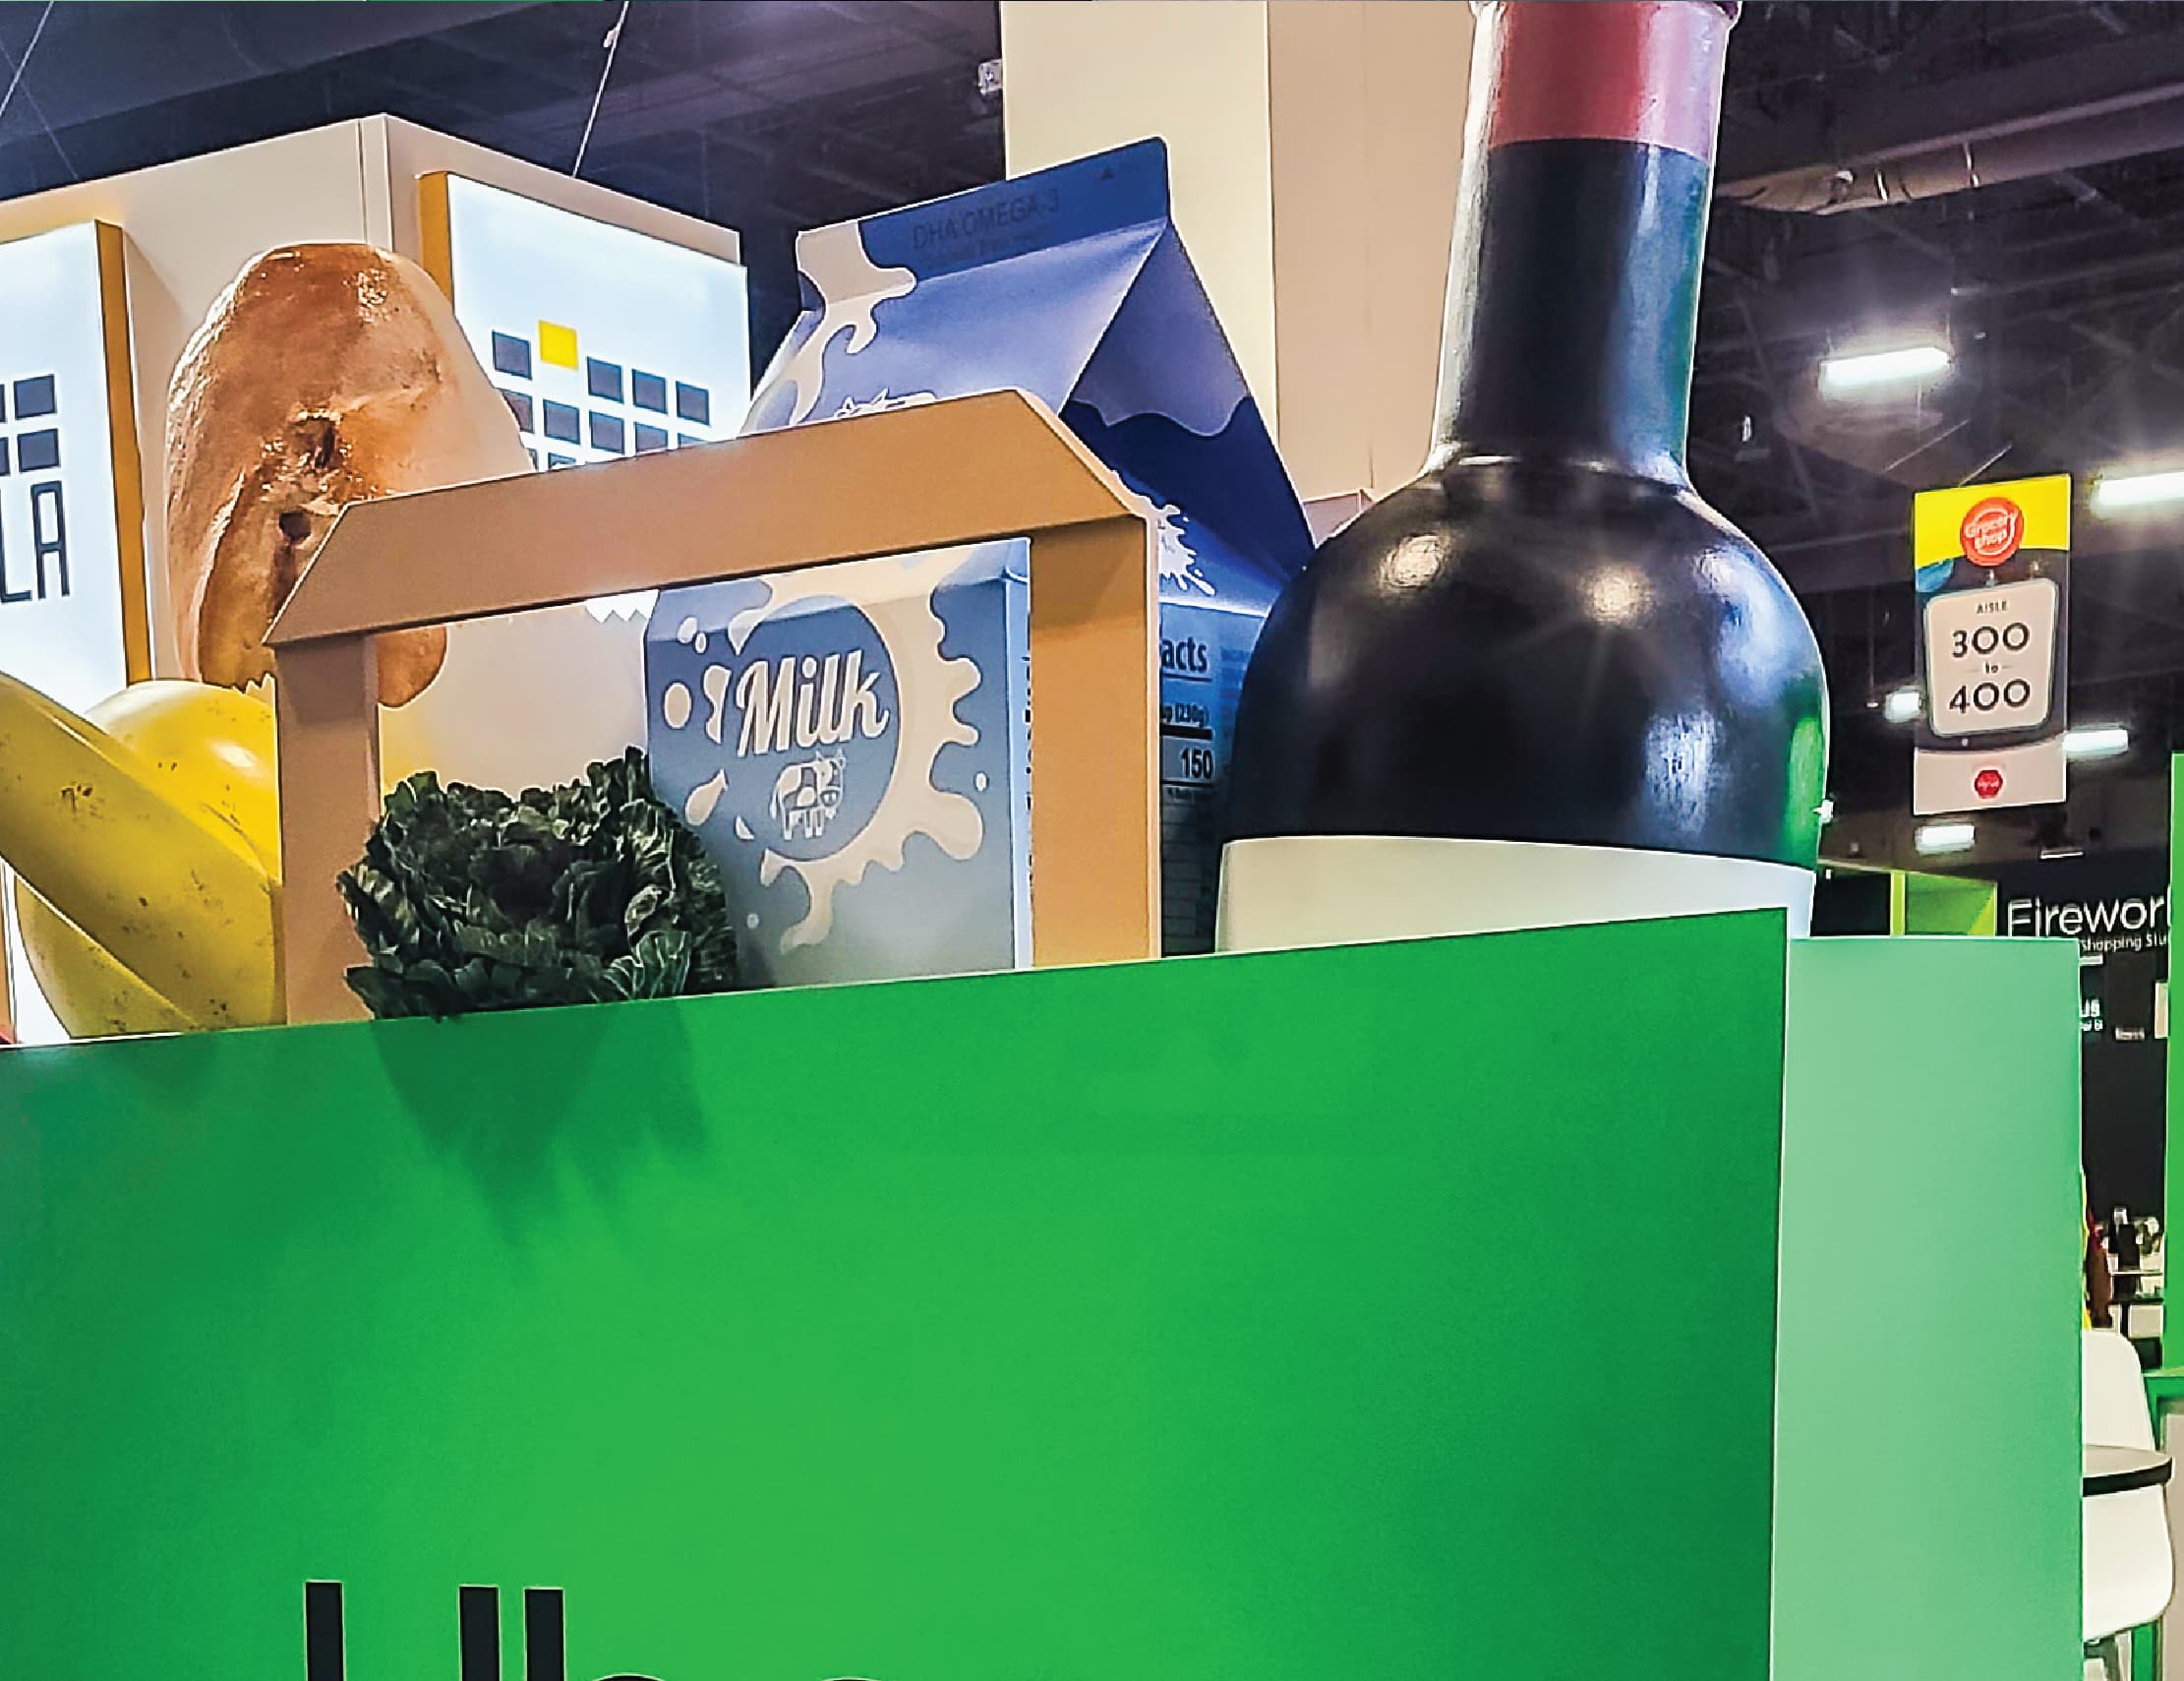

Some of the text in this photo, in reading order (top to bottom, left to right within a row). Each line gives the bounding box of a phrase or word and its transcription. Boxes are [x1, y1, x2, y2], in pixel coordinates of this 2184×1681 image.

[1976, 600, 2008, 615] AISLE
[1952, 622, 2031, 658] 300
[1983, 660, 1999, 675] to
[735, 648, 890, 758] Milk
[1948, 679, 2031, 714] 400
[1180, 746, 1214, 780] 150
